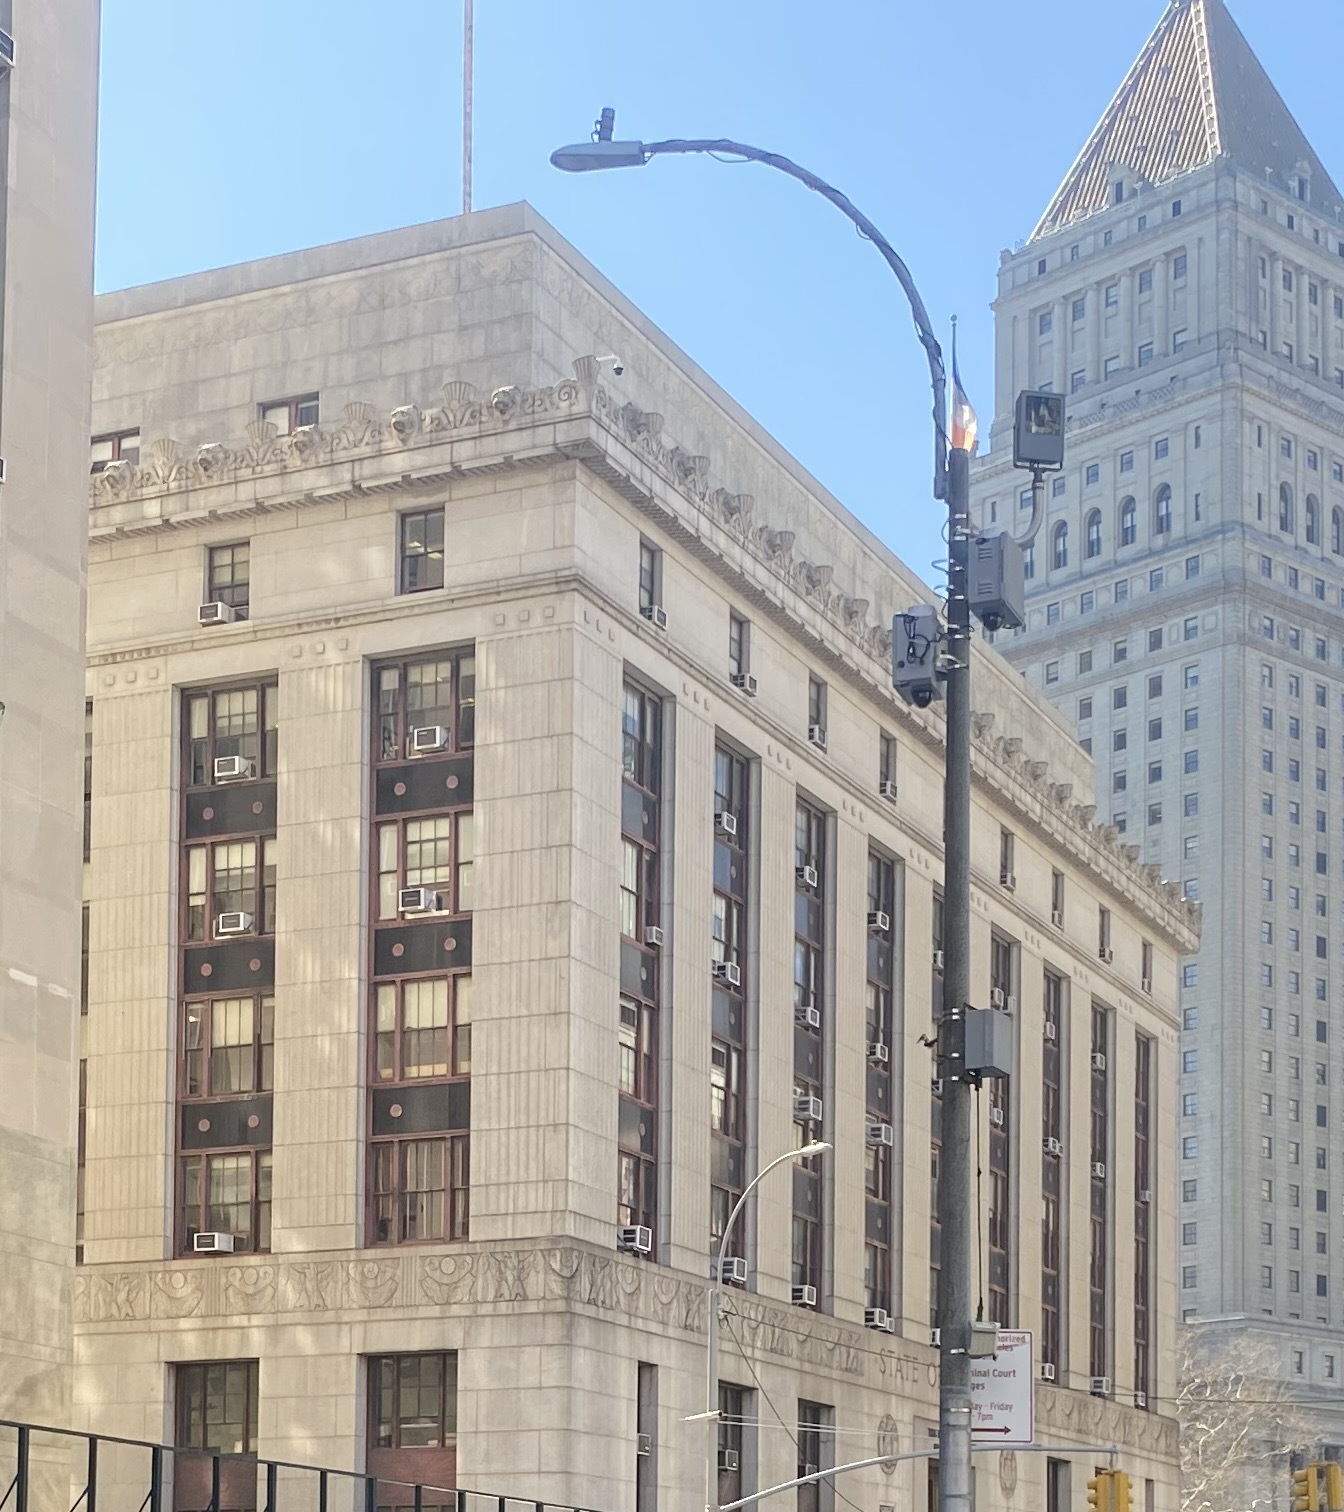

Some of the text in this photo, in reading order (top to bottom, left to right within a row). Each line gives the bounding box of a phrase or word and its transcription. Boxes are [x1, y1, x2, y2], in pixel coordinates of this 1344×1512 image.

[880, 1348, 918, 1383] STATE
[992, 1368, 1017, 1378] Court
[989, 1402, 1014, 1412] Friday
